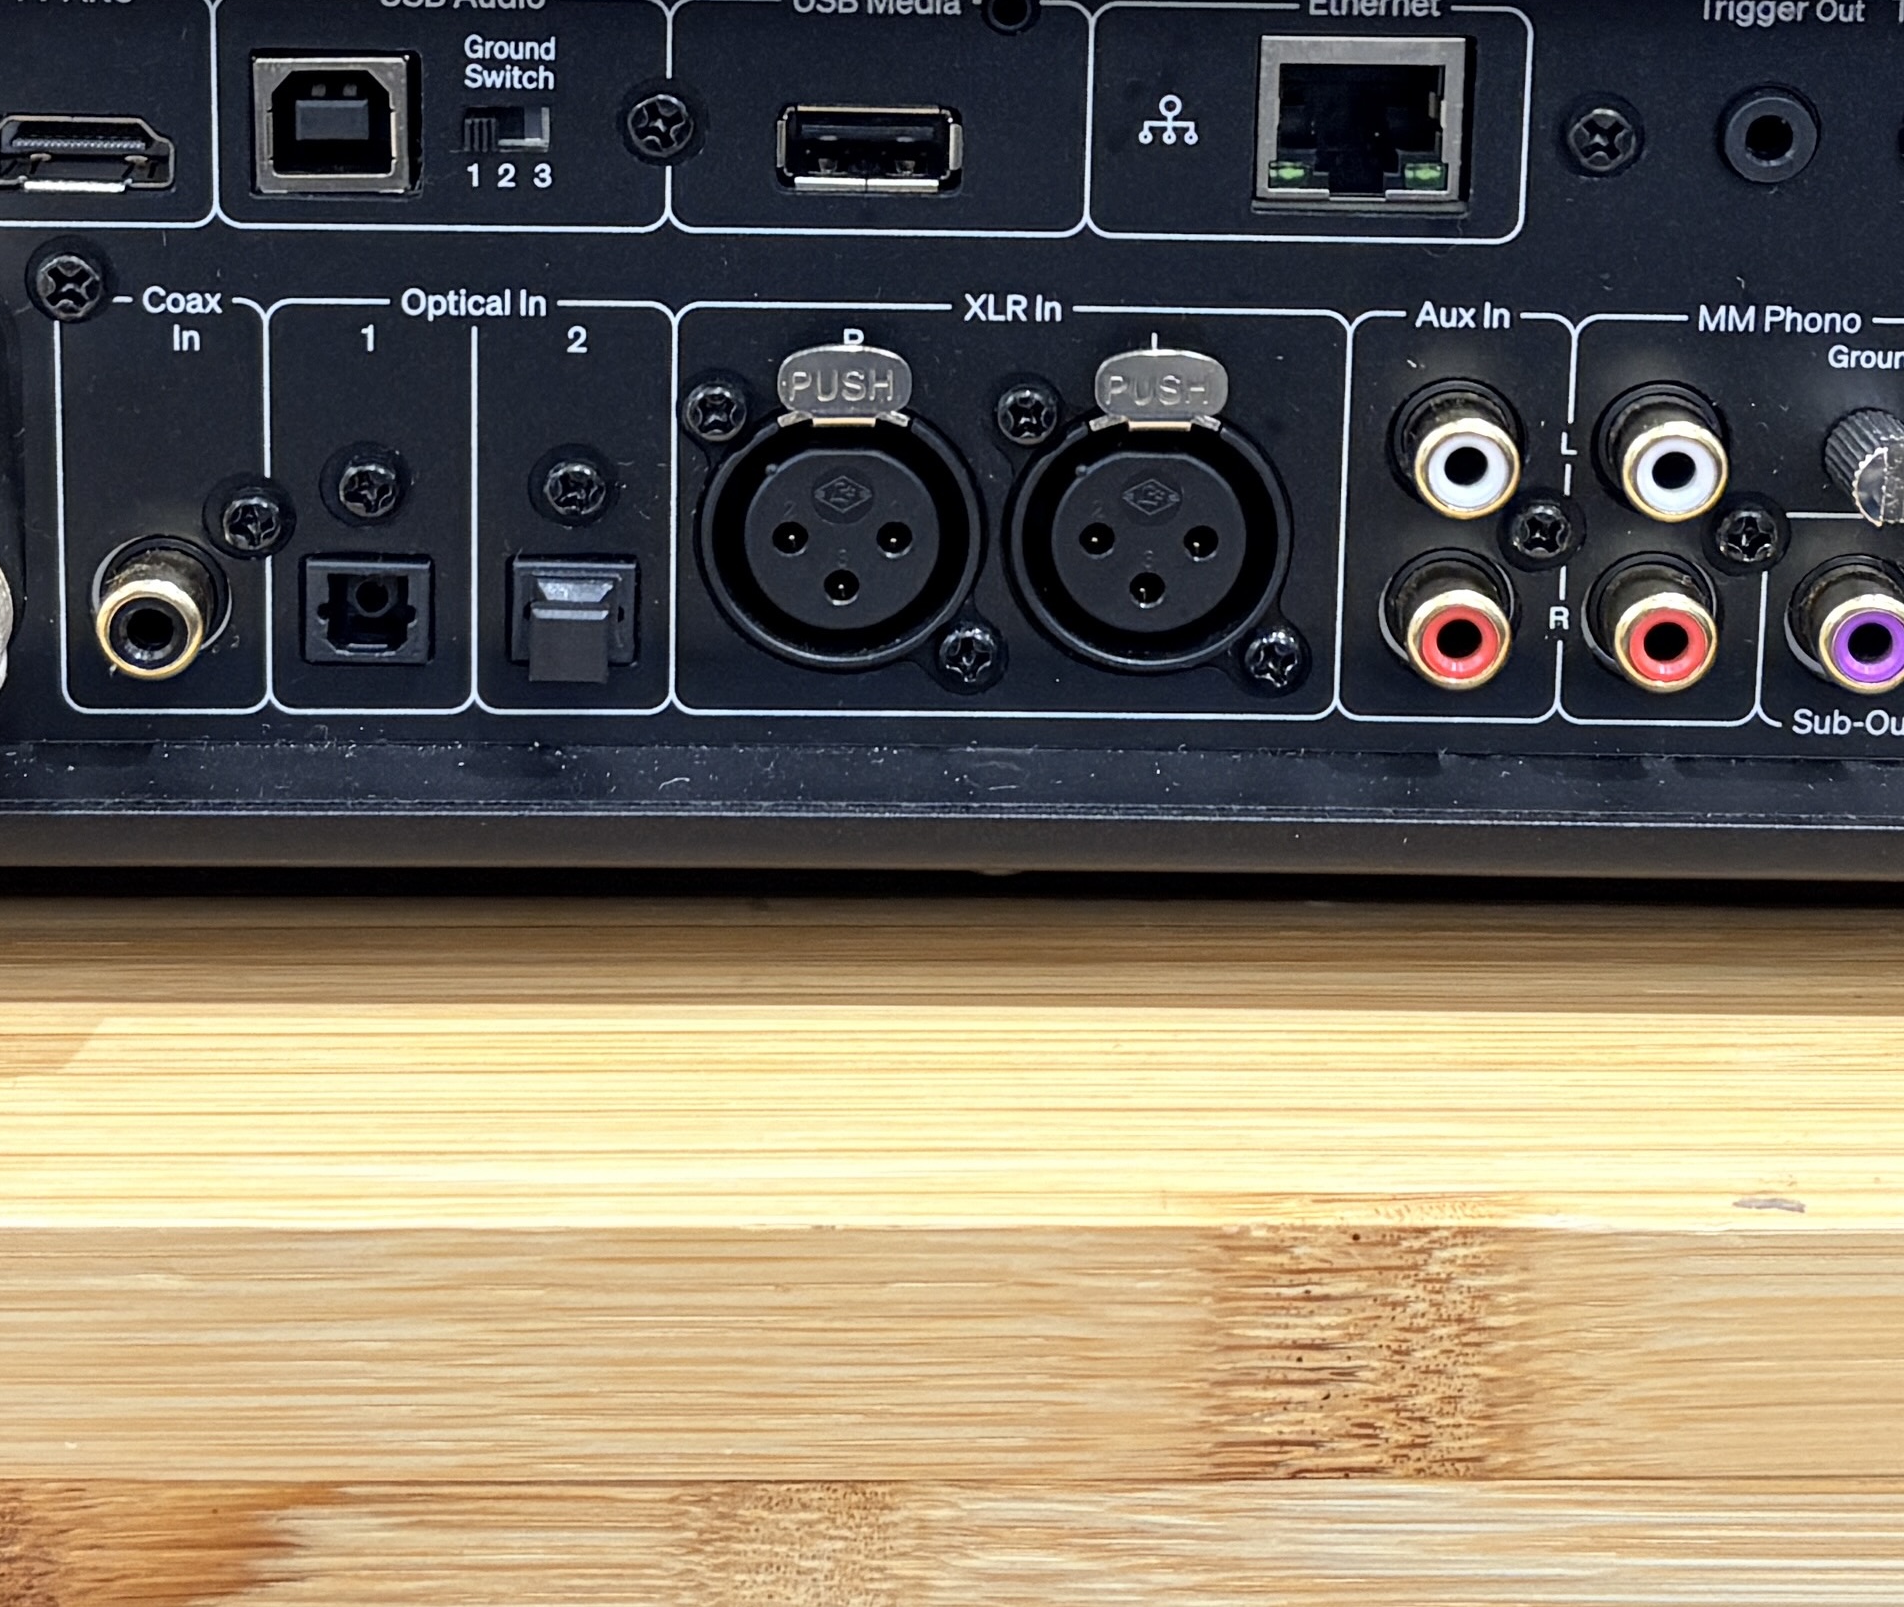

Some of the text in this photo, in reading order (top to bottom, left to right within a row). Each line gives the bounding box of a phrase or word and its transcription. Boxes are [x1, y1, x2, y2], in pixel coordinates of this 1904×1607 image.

[463, 33, 556, 61] Ground
[463, 63, 555, 90] Switch
[466, 162, 553, 189] 1 2 3
[141, 285, 223, 314] Coax
[400, 287, 547, 322] Optical In
[963, 293, 1062, 322] XLR In
[1414, 300, 1511, 329] Aux In
[1698, 304, 1862, 334] MM Phono
[172, 323, 201, 352] In
[360, 324, 375, 352] 1
[566, 325, 588, 354] 2
[788, 368, 895, 403] PUSH
[1105, 374, 1210, 406] PUSH
[1560, 431, 1578, 456] L
[1549, 605, 1570, 630] R
